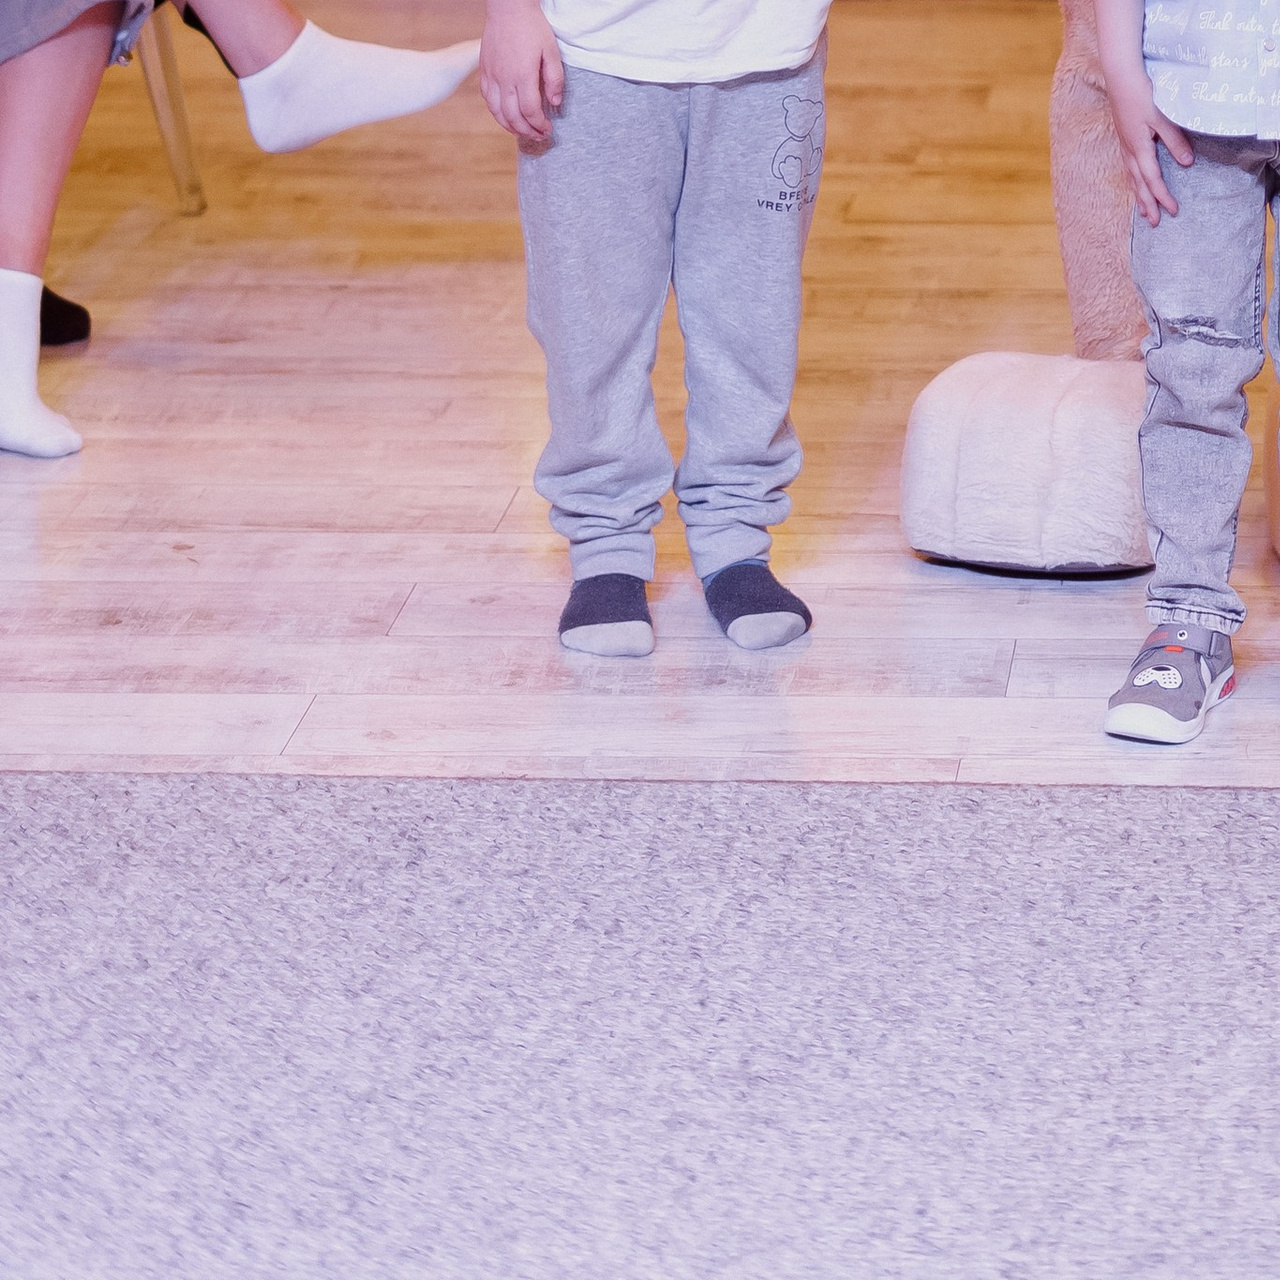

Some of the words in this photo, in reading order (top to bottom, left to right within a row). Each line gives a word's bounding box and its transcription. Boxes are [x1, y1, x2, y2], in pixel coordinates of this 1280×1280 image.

[1200, 10, 1233, 31] Think
[1211, 51, 1250, 69] stars
[1260, 59, 1280, 76] you
[1192, 82, 1229, 103] Think
[757, 198, 793, 213] VREY
